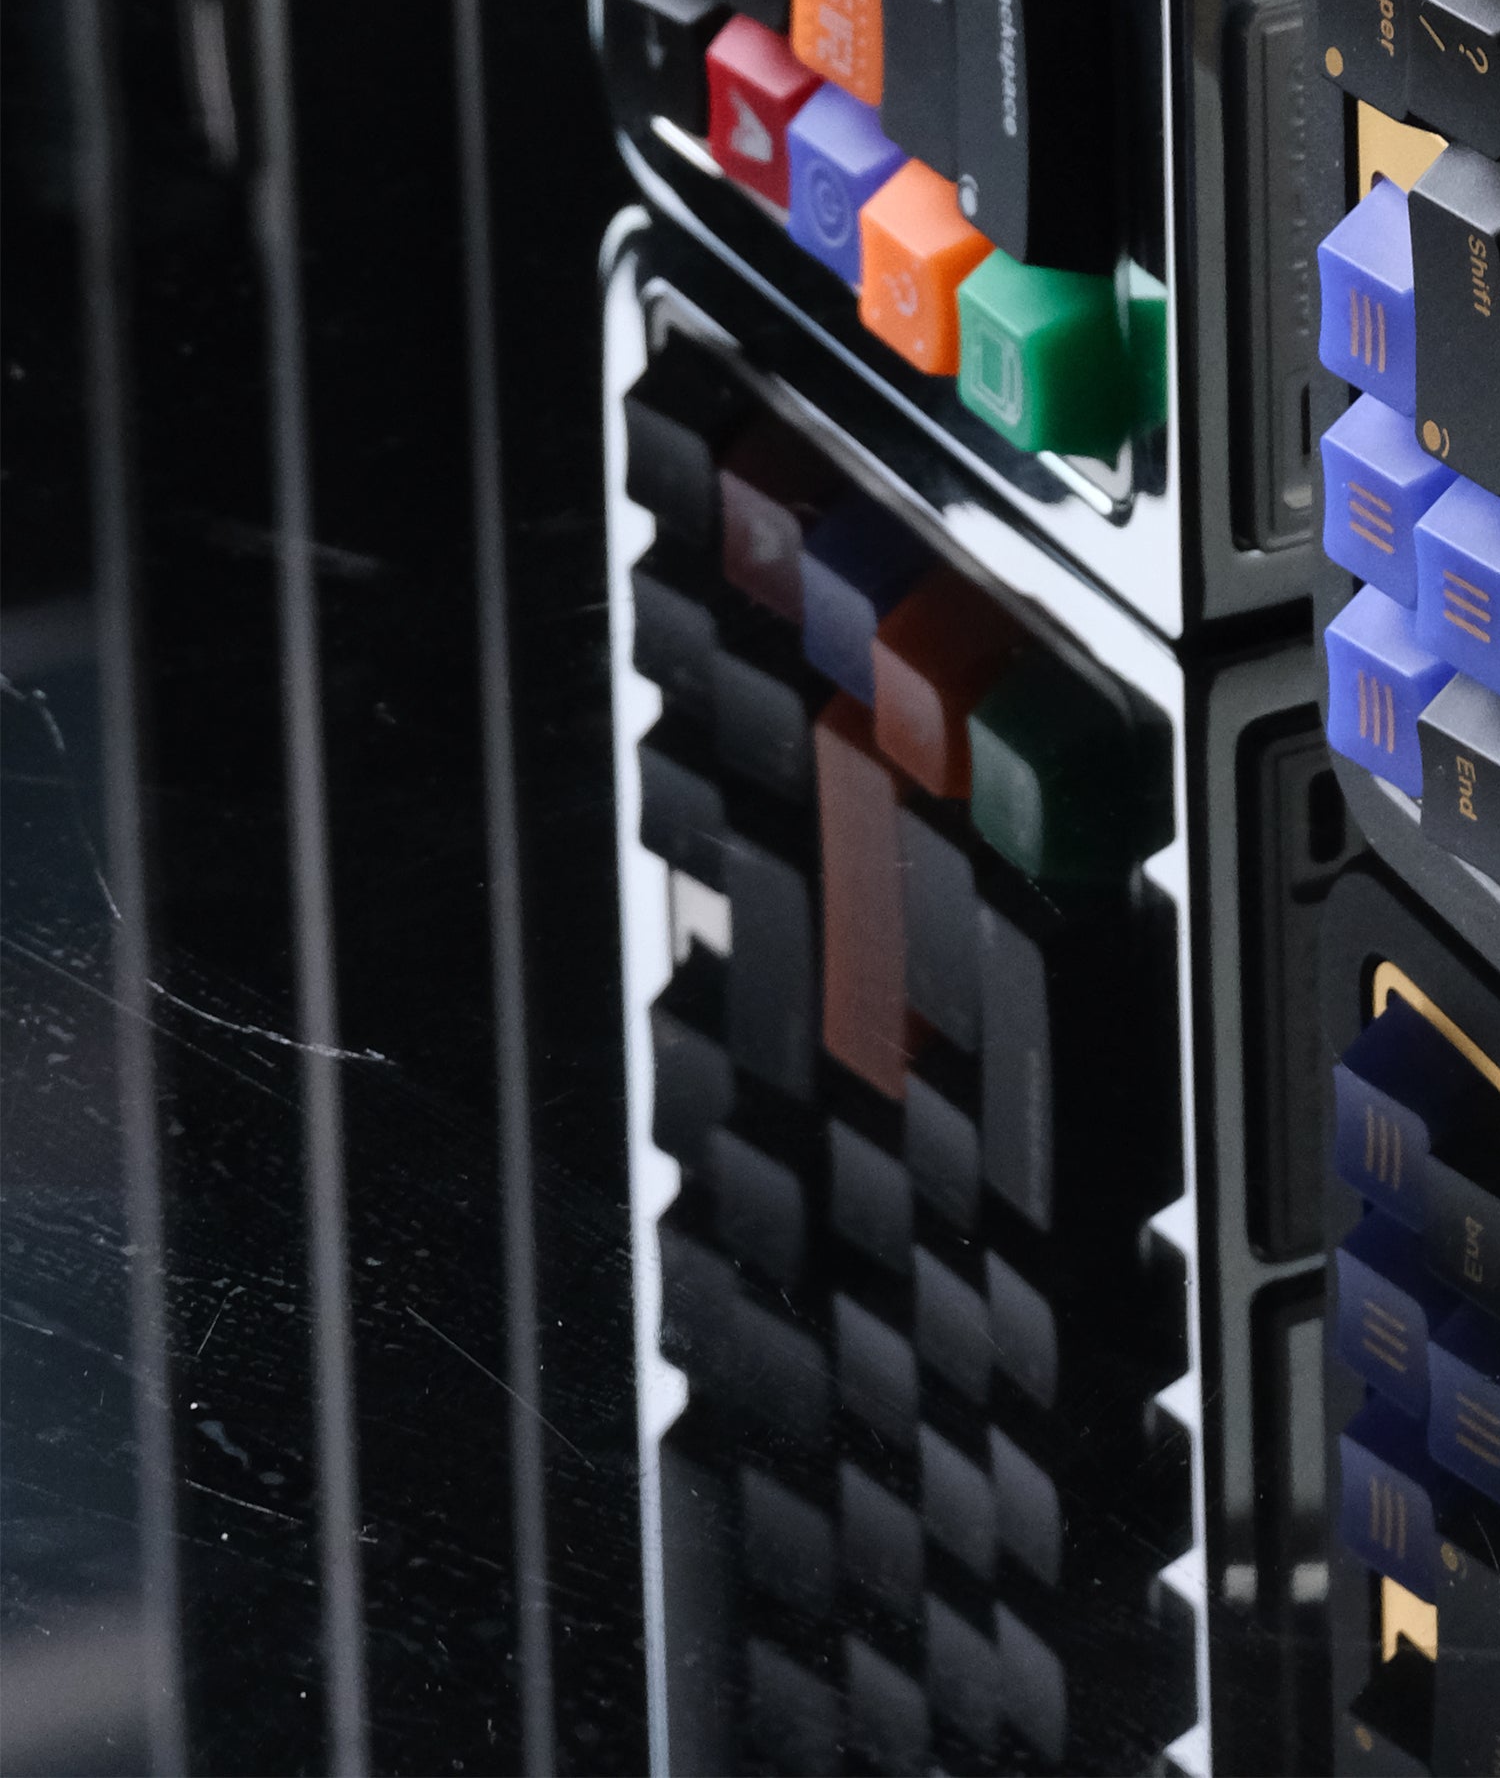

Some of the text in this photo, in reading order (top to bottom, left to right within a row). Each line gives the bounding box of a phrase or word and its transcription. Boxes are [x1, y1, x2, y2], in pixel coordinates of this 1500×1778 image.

[1419, 15, 1445, 51] /
[1459, 44, 1488, 73] ?
[1469, 235, 1490, 316] Shift
[1457, 756, 1477, 820] End
